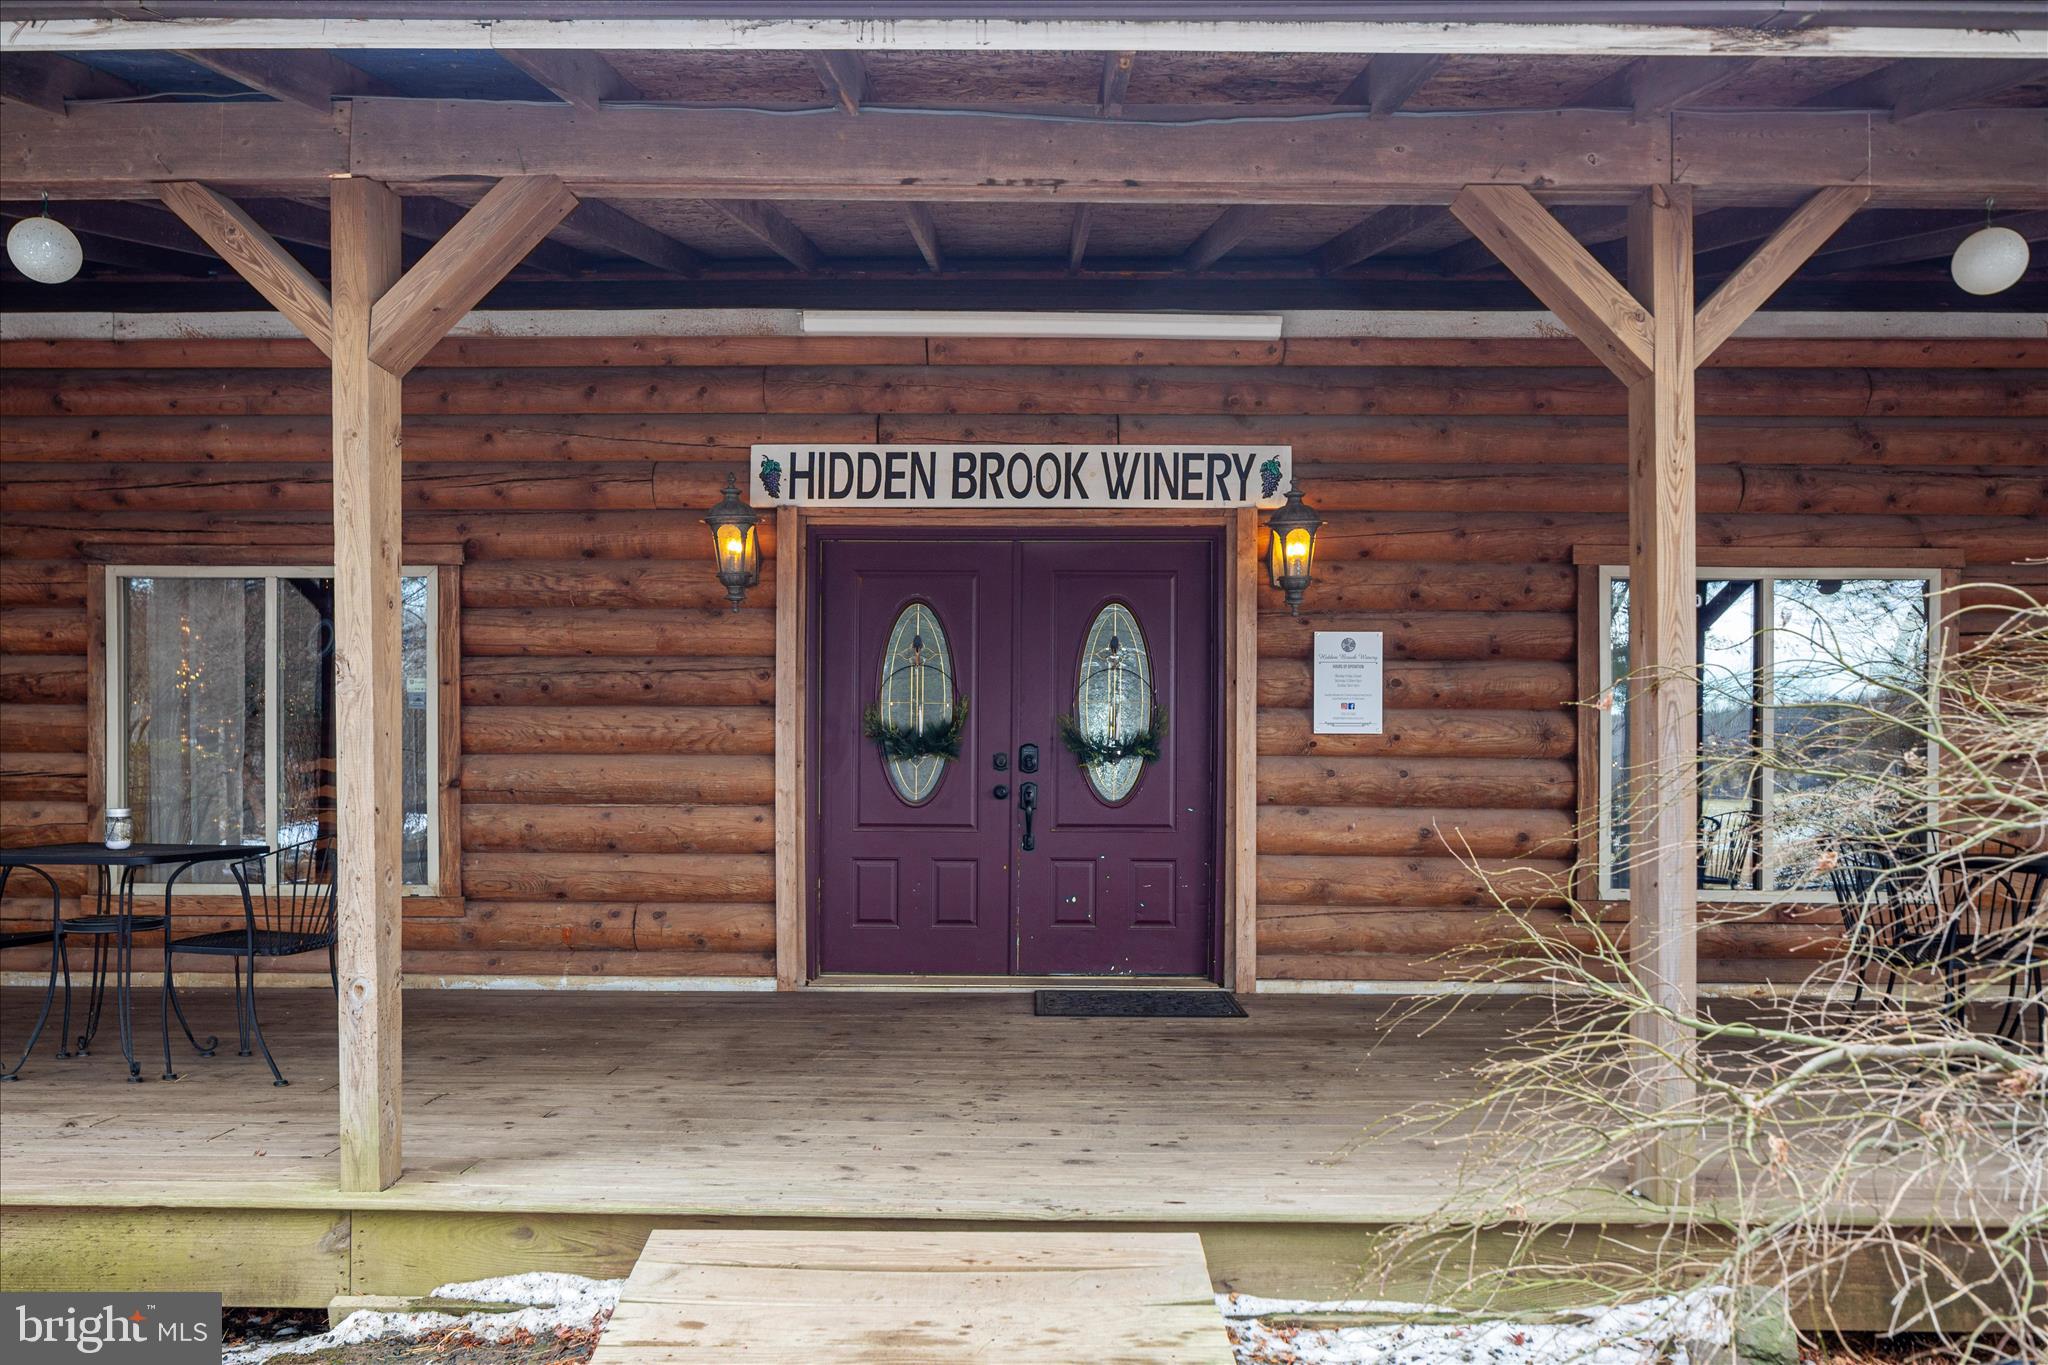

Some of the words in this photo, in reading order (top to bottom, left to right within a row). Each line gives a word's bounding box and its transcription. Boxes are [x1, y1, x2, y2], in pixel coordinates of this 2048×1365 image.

[788, 451, 937, 500] HIDDEN
[951, 451, 1090, 500] BROOK
[1100, 451, 1257, 502] WINERY
